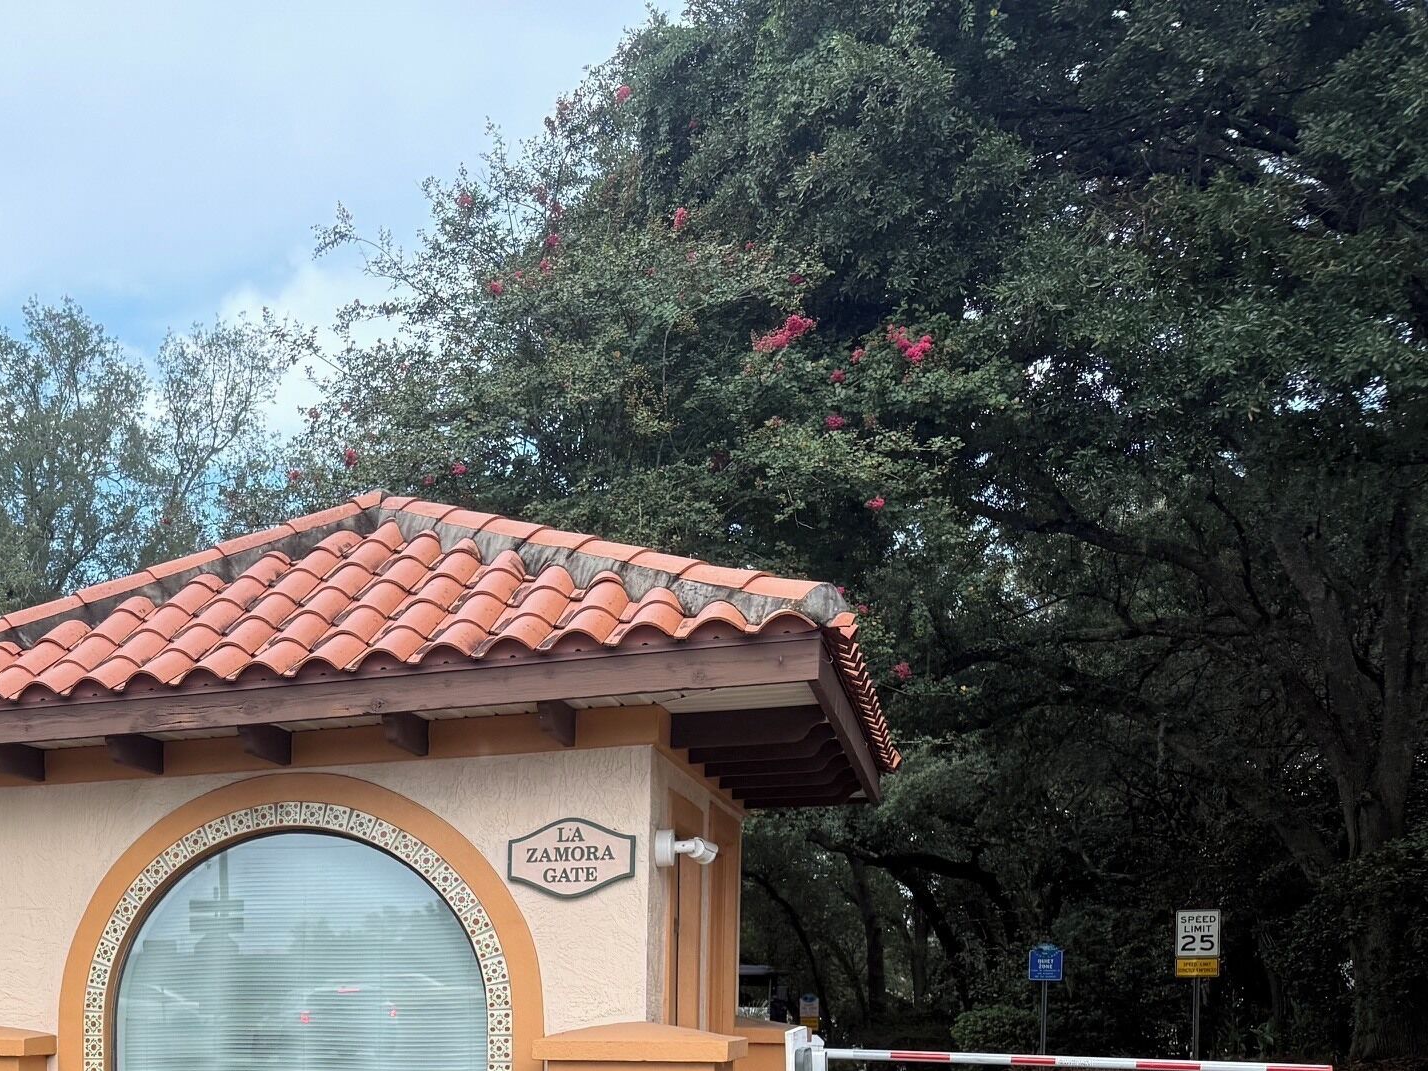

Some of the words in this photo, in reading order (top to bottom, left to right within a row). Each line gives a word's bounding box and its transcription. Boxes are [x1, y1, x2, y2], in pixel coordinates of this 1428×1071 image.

[557, 827, 585, 843] LA
[526, 845, 615, 863] ZAMORA
[543, 867, 598, 884] GATE
[1180, 915, 1217, 924] SPEED
[1184, 925, 1212, 933] LIMIT
[1180, 934, 1215, 951] 25
